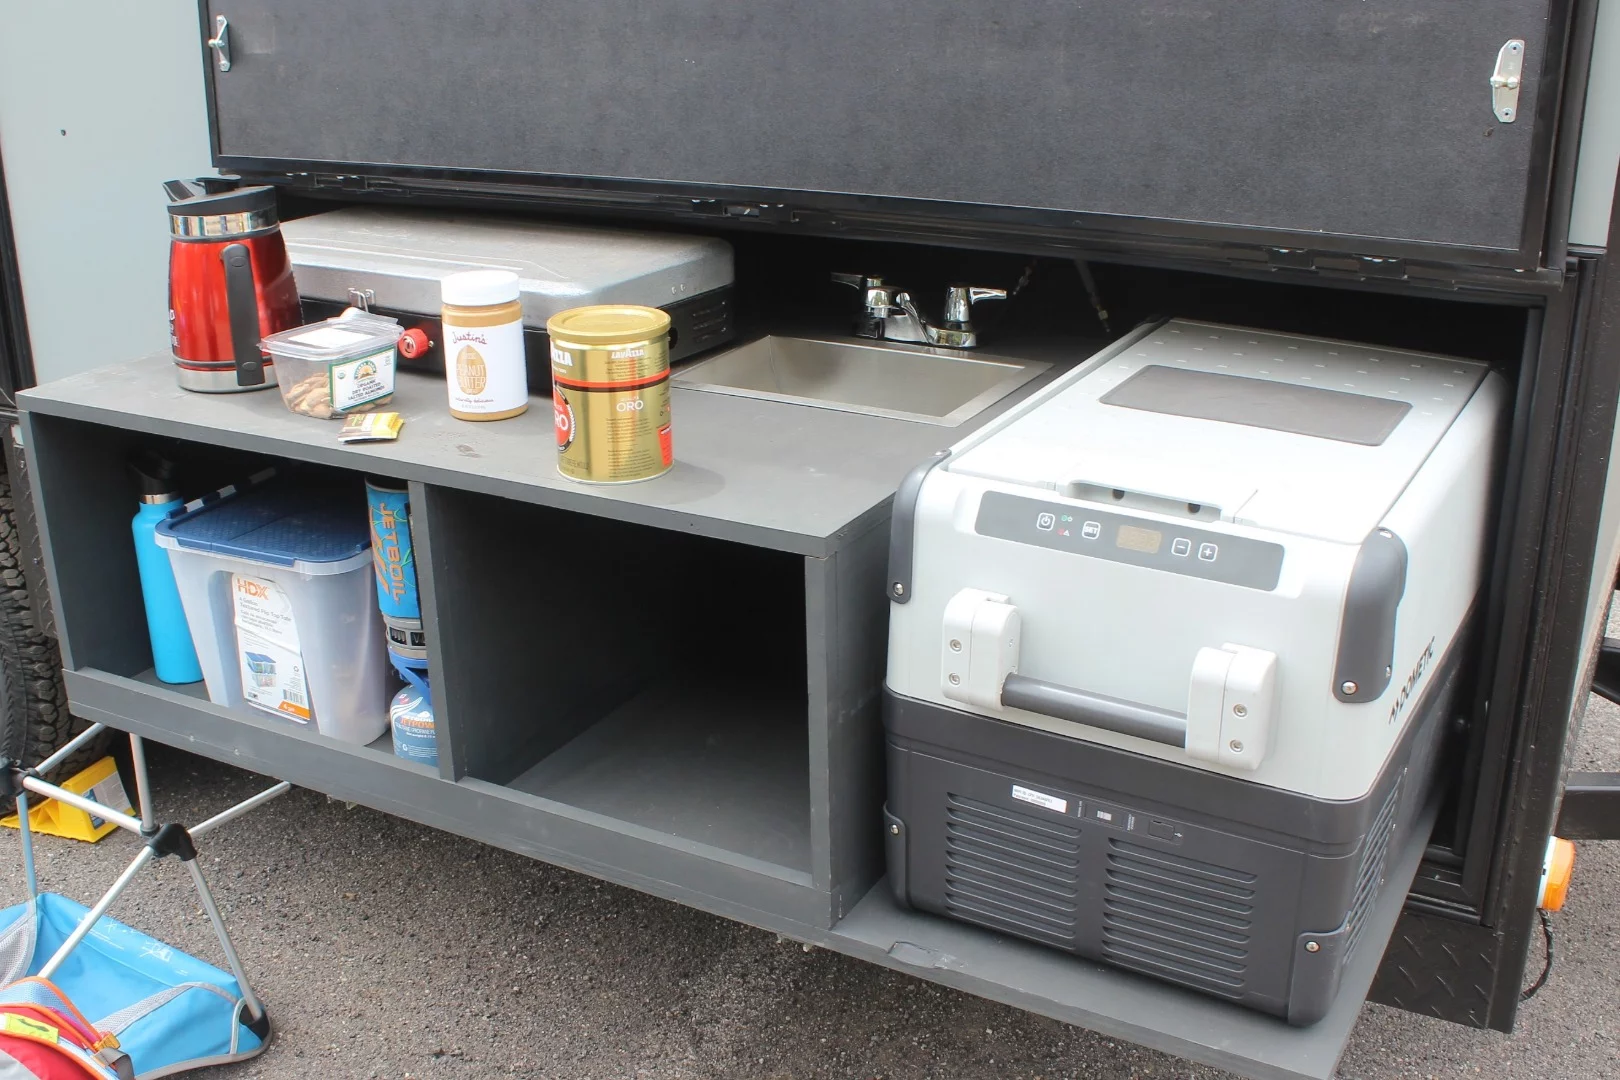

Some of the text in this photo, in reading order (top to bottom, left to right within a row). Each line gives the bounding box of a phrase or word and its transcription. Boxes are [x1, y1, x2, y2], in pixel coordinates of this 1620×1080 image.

[452, 331, 487, 345] Justin's
[551, 341, 573, 366] AZZA
[611, 348, 645, 359] LAVAZZA
[616, 400, 644, 412] ORO
[554, 410, 569, 431] RO
[1084, 526, 1098, 534] SET
[380, 502, 407, 605] JETBOIL
[237, 578, 270, 601] HDX
[1398, 635, 1435, 713] DOMETIC
